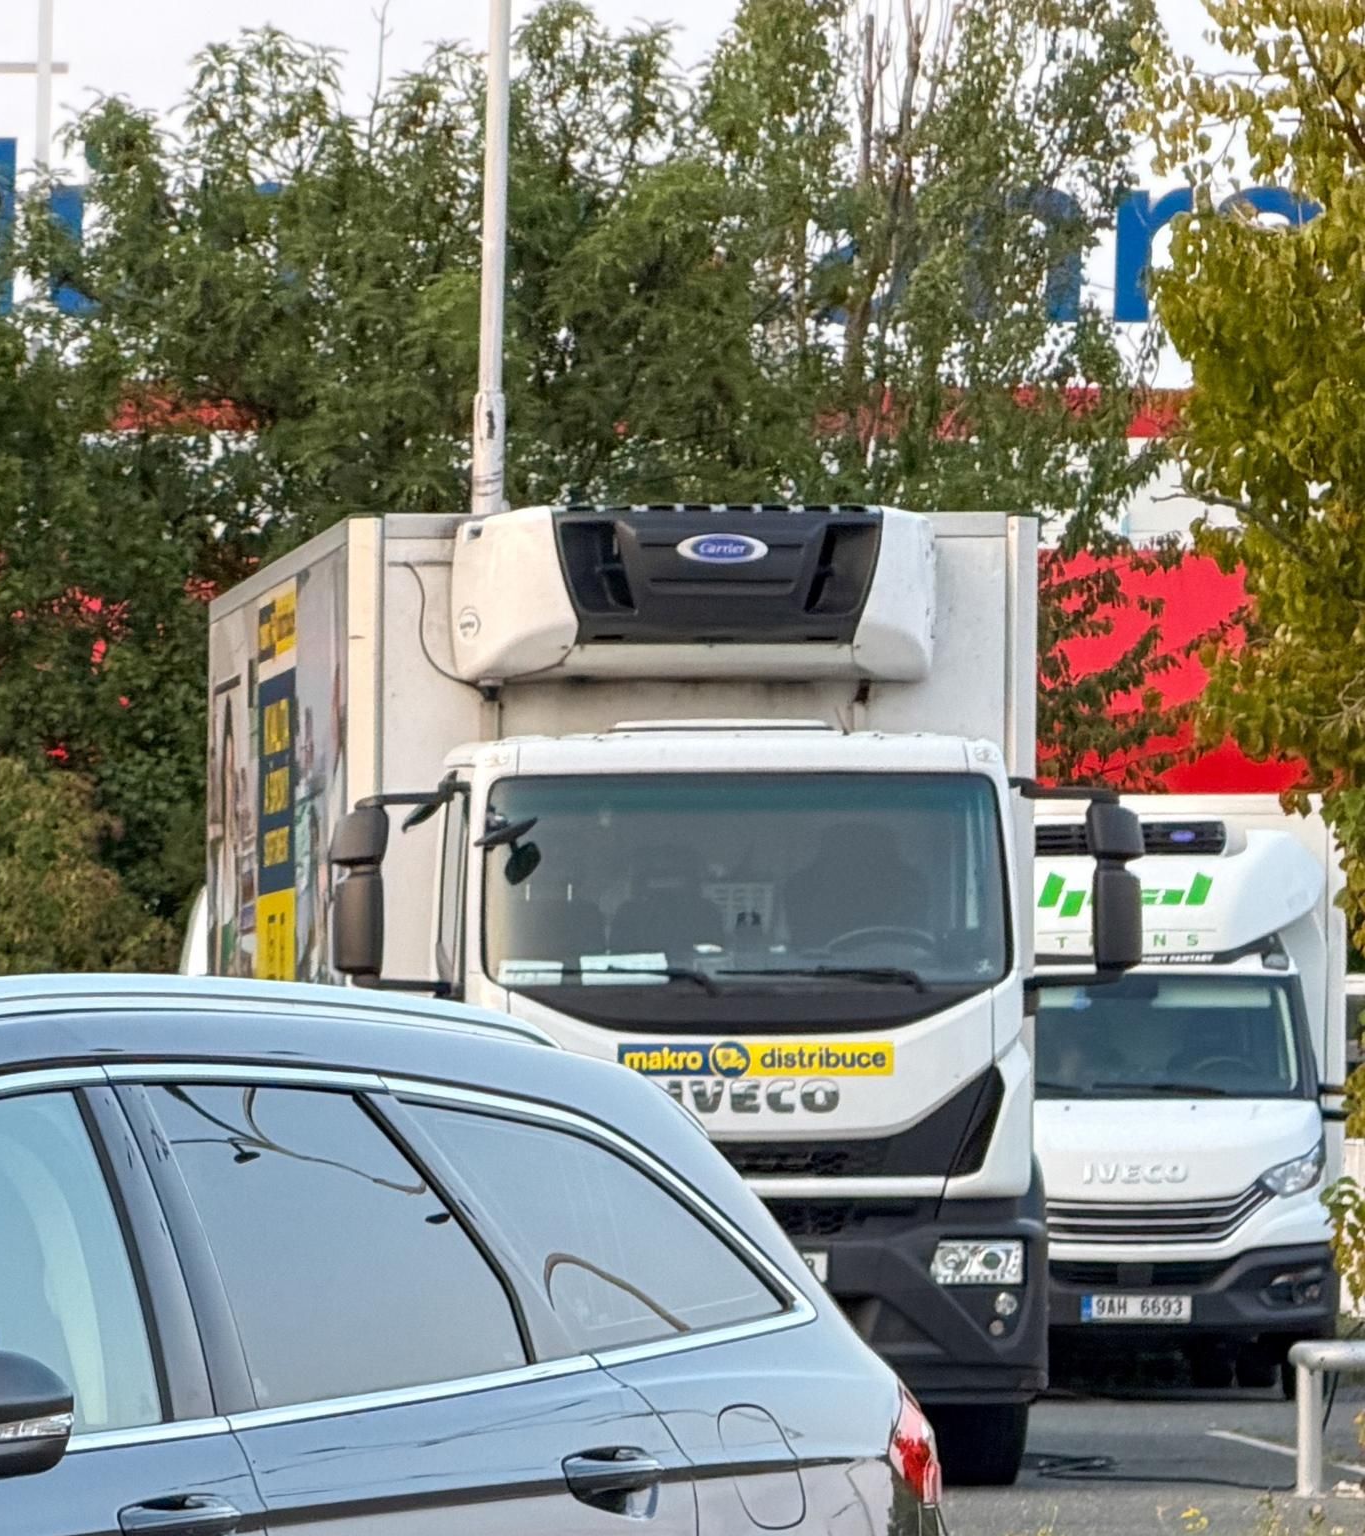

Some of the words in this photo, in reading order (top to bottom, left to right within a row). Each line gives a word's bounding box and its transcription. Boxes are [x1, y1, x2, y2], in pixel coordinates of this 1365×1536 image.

[698, 541, 747, 554] Carrier
[623, 1047, 703, 1071] makro
[760, 1047, 886, 1069] distribuce
[668, 1078, 840, 1114] IVECO
[1082, 1162, 1188, 1185] IVECO
[1095, 1298, 1127, 1315] 9AH
[1140, 1297, 1183, 1315] 6693
